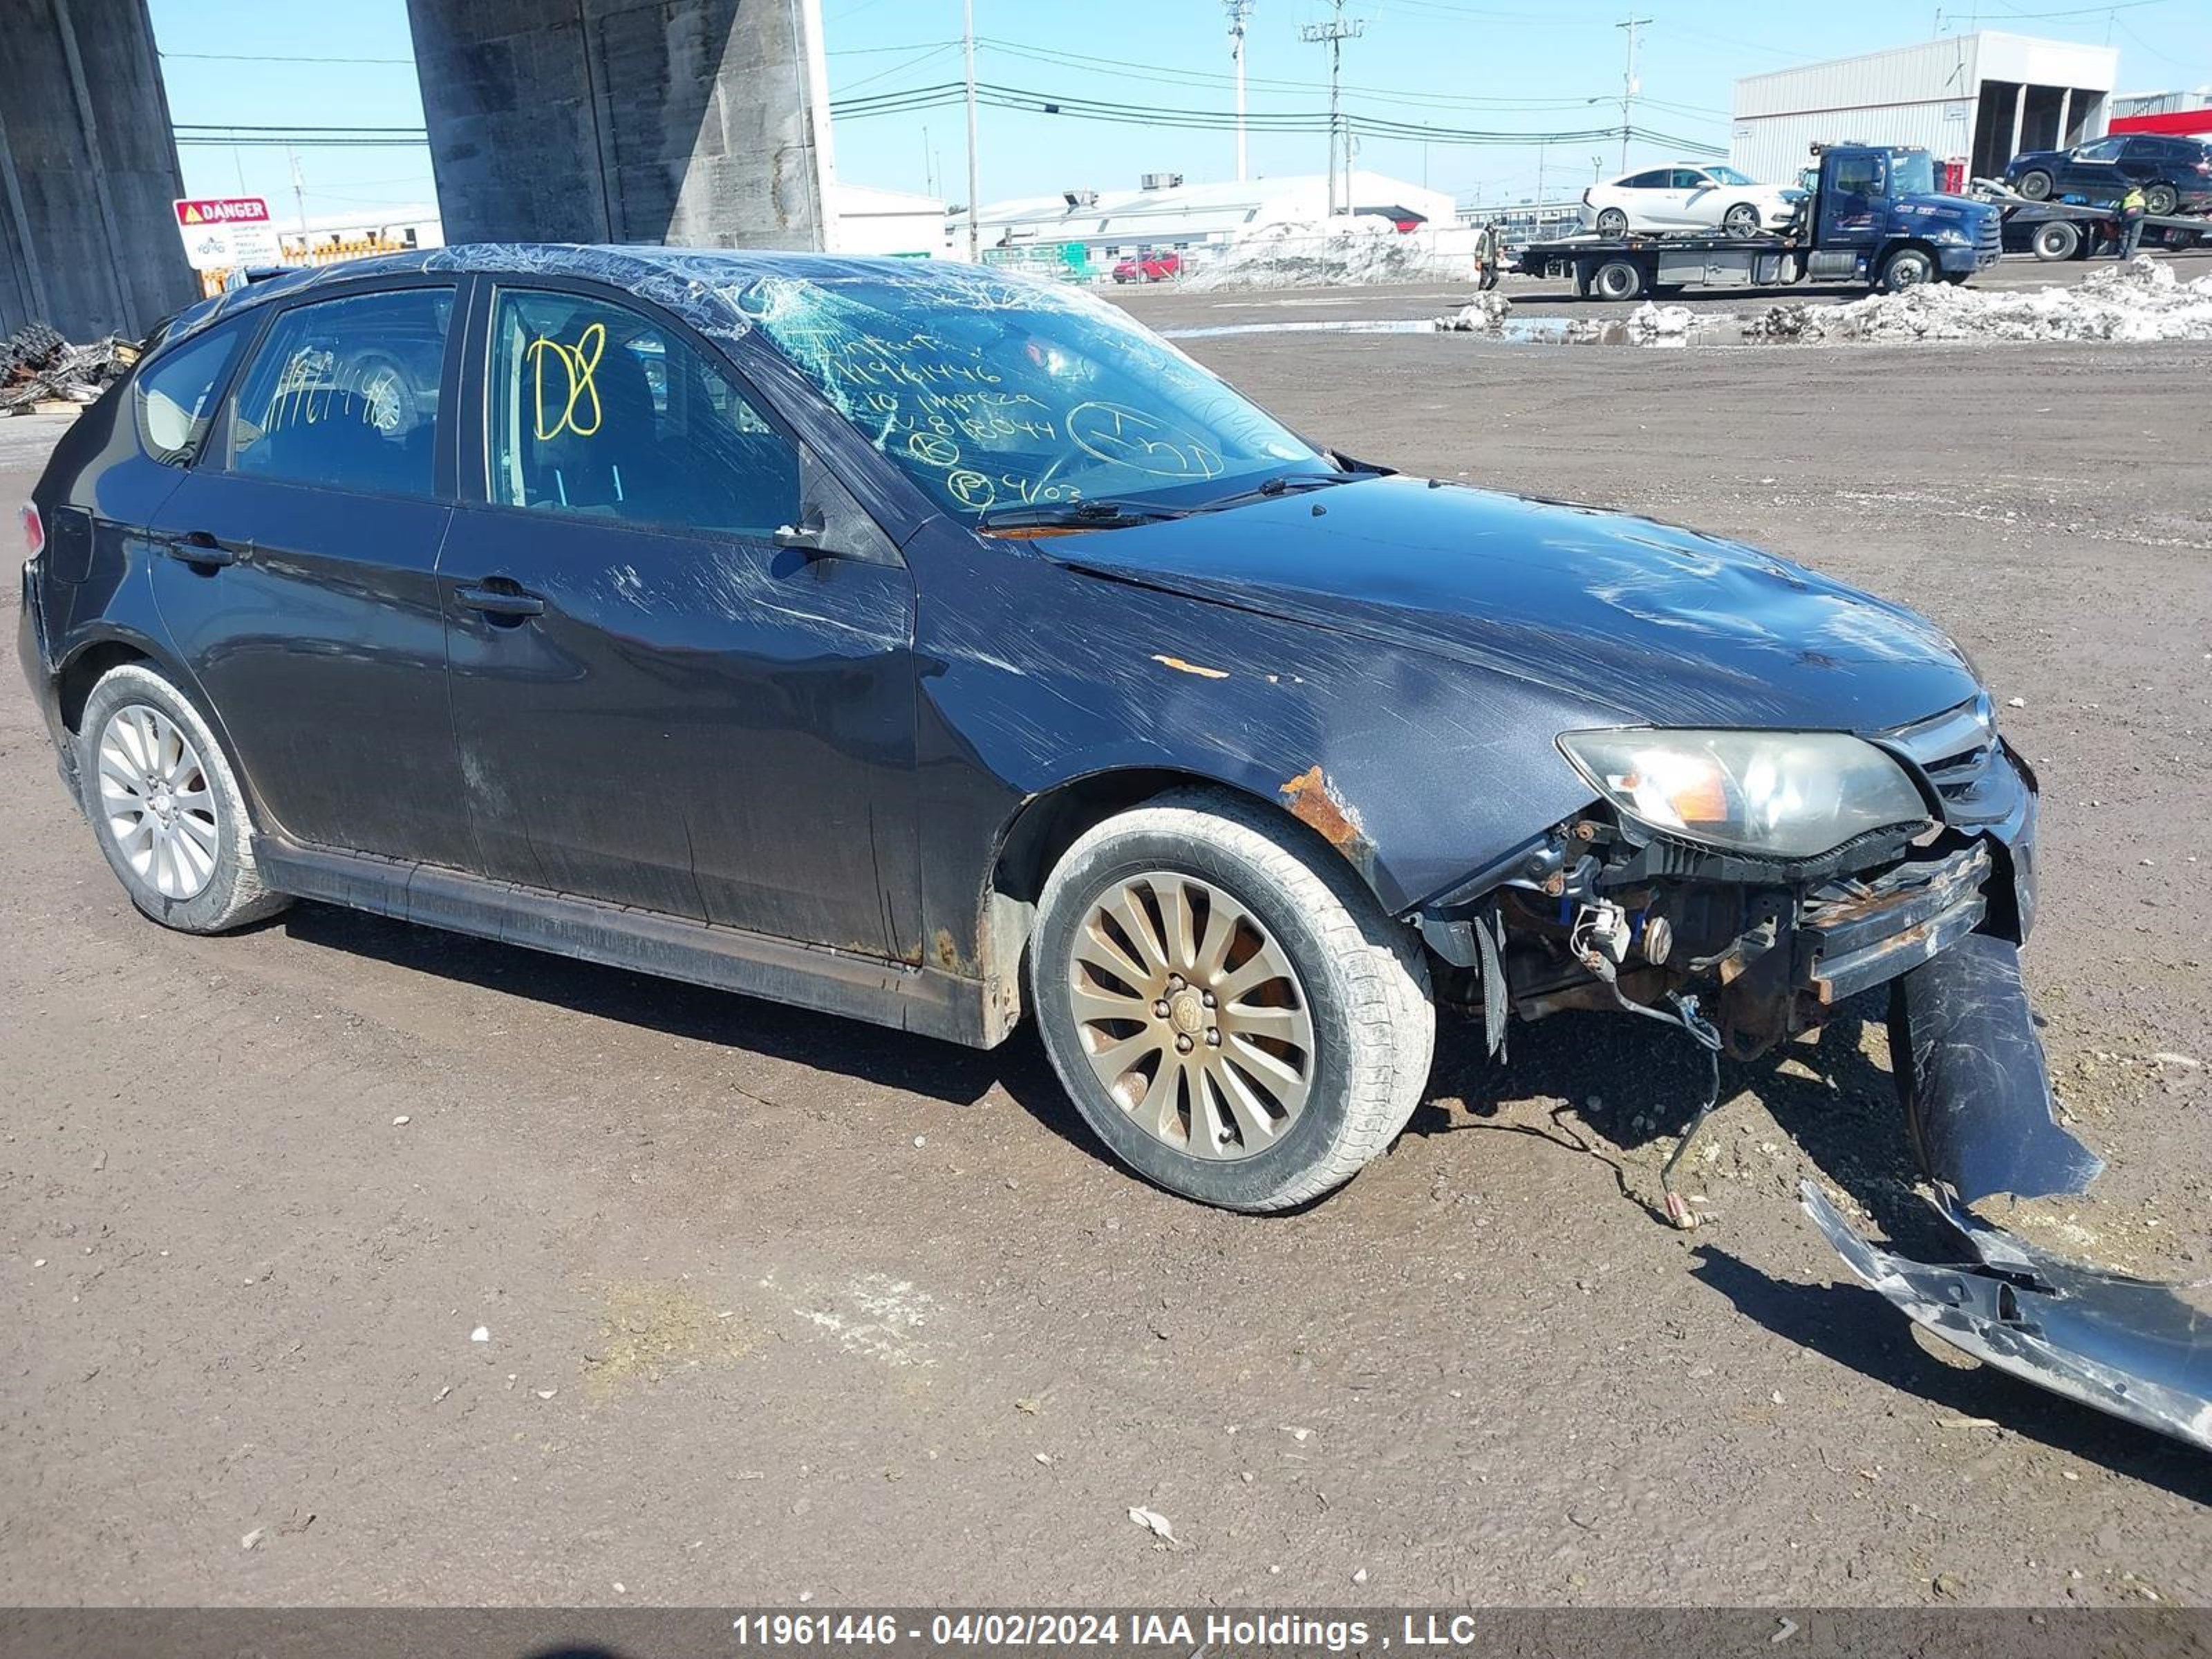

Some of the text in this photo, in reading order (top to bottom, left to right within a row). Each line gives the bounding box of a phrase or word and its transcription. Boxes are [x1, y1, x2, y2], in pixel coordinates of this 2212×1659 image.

[202, 202, 265, 221] DANGER
[527, 323, 606, 440] D8
[834, 361, 1002, 385] 11961446
